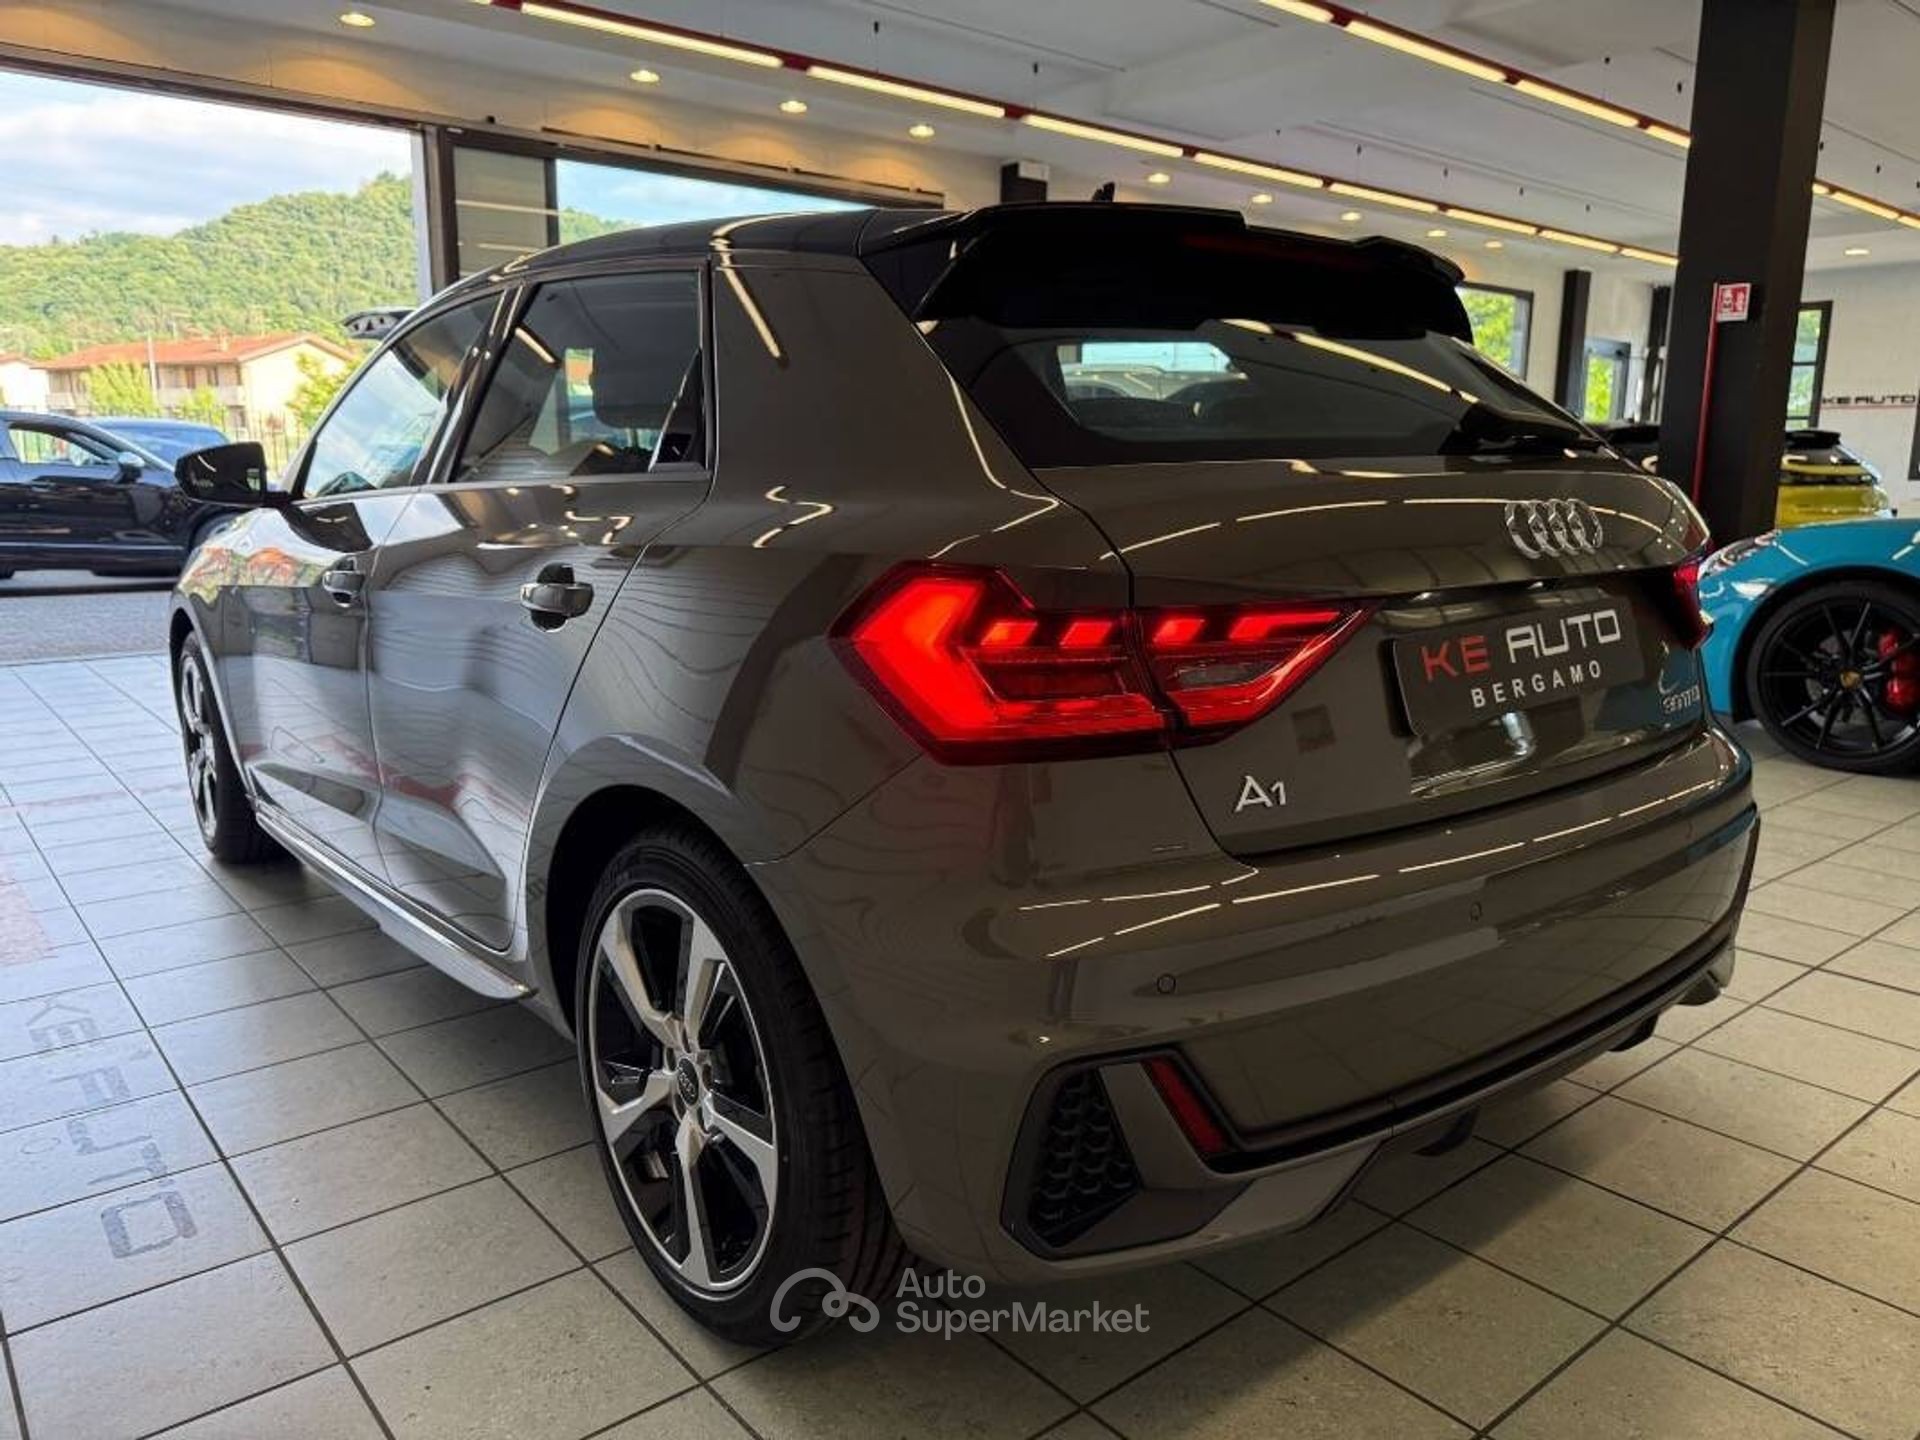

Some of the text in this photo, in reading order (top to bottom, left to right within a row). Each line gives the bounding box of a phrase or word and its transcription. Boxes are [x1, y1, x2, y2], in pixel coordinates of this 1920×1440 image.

[1822, 395, 1916, 404] KE AUTO
[1420, 608, 1621, 683] KE AUTO
[1470, 659, 1601, 709] BERGAMO
[1234, 775, 1286, 813] A1
